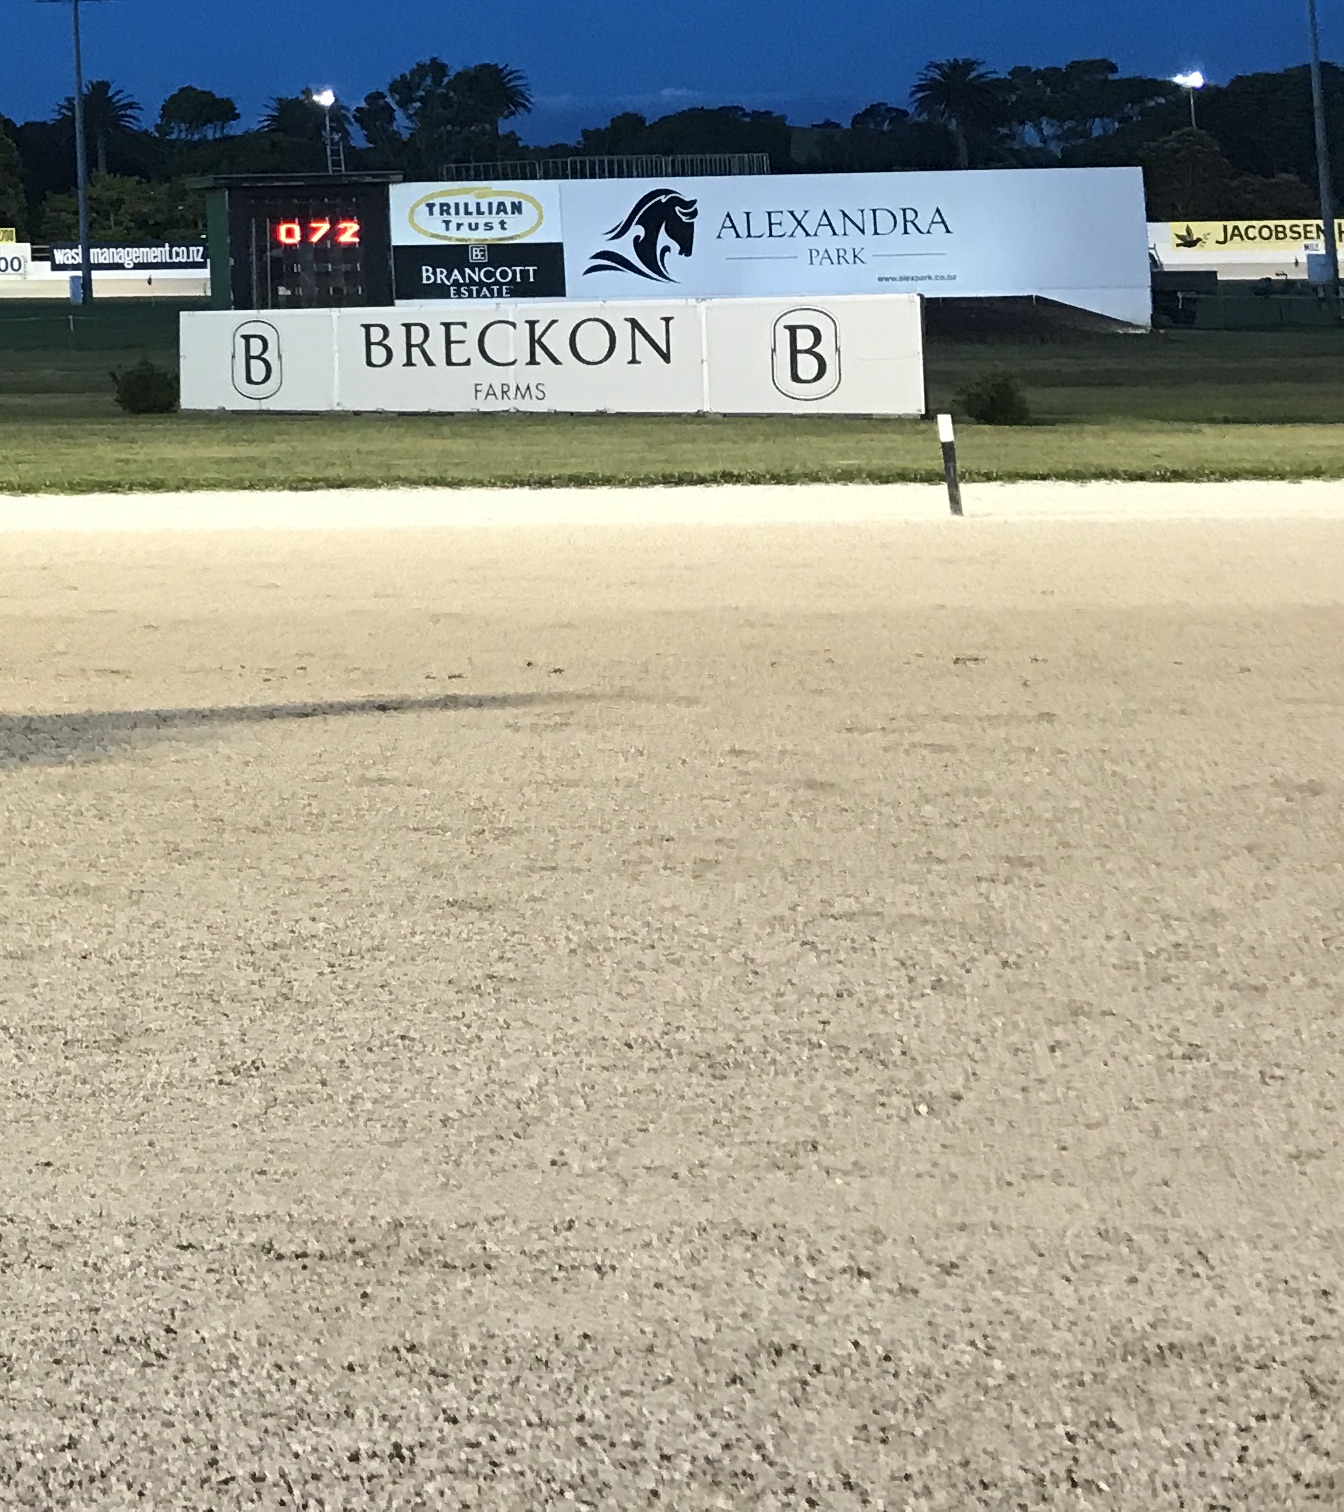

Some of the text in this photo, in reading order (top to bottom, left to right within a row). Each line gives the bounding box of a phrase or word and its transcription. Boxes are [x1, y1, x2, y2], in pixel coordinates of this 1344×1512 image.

[424, 201, 523, 216] TRILLIAN
[442, 219, 508, 231] Trust
[716, 207, 954, 239] ALEXANDRA
[808, 246, 867, 265] PARK
[421, 265, 538, 286] BRANCOTT
[450, 286, 511, 298] ESTATE
[360, 316, 675, 368] BRECKON
[240, 333, 272, 385] B
[783, 324, 828, 384] B
[473, 382, 547, 401] FARMS
